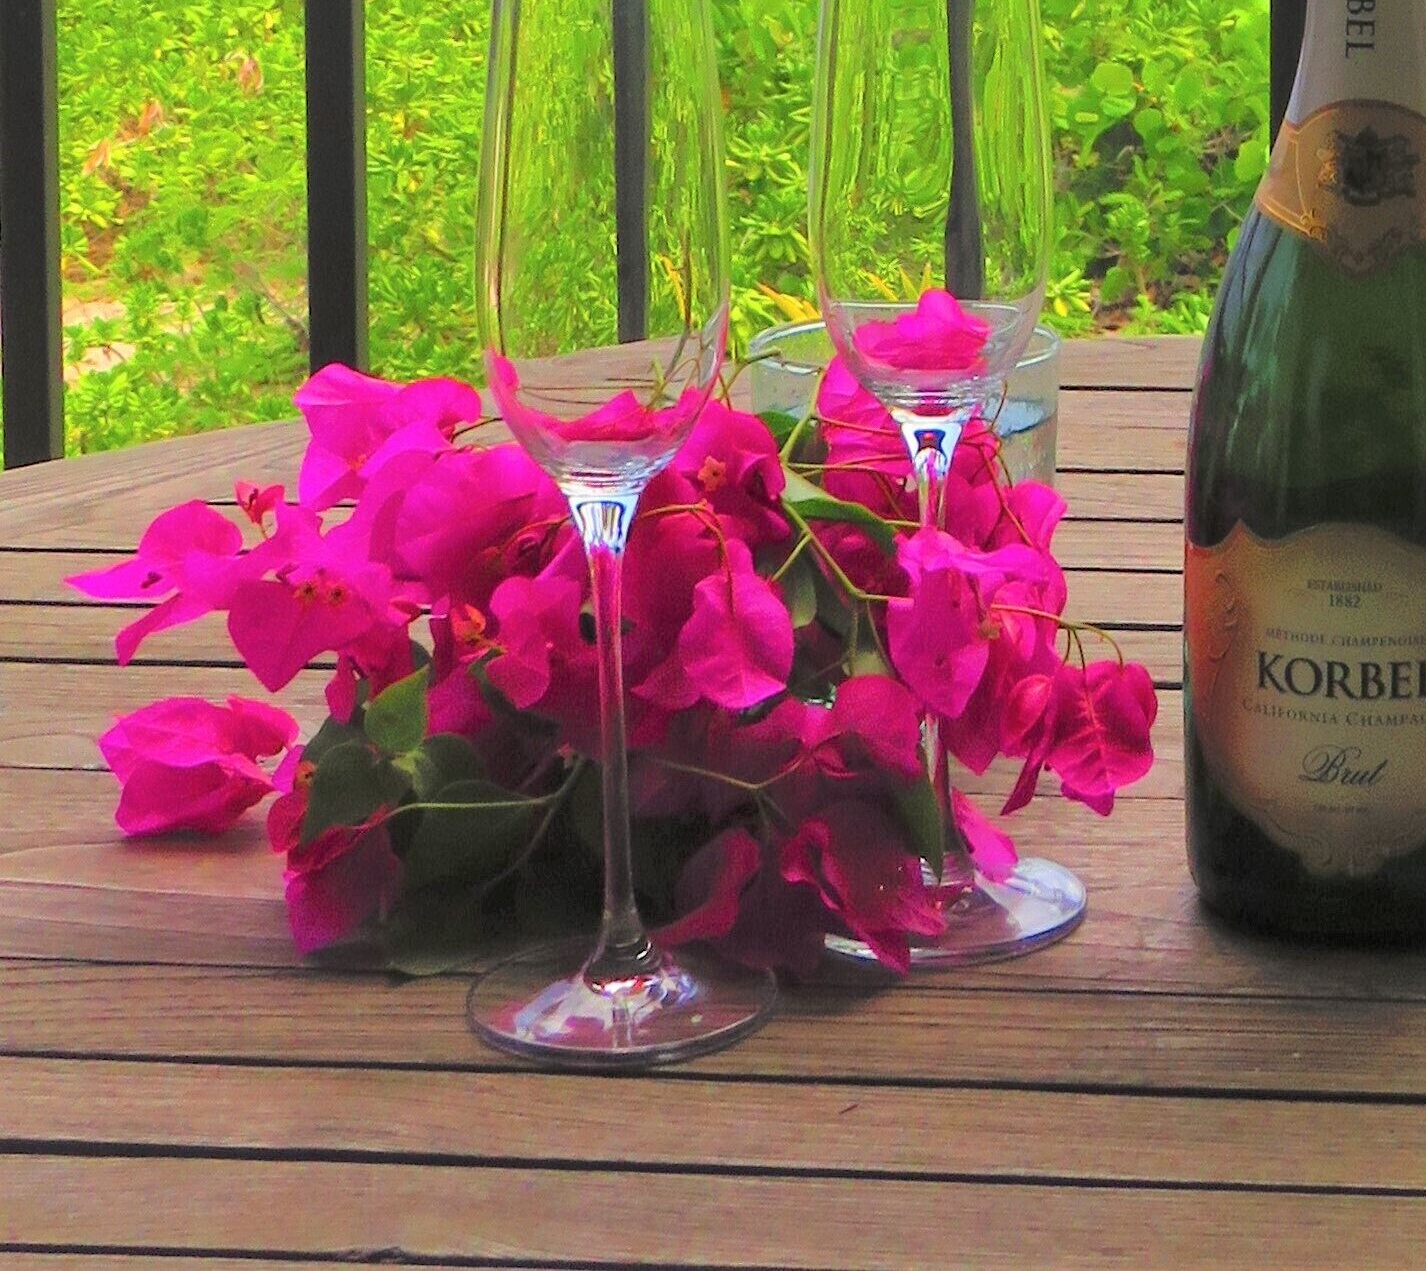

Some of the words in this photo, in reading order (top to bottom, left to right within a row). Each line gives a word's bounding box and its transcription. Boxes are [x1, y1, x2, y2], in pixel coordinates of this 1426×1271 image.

[1328, 594, 1362, 609] 1882
[1242, 698, 1338, 725] CALIFORNIA
[1298, 744, 1388, 787] Brut
